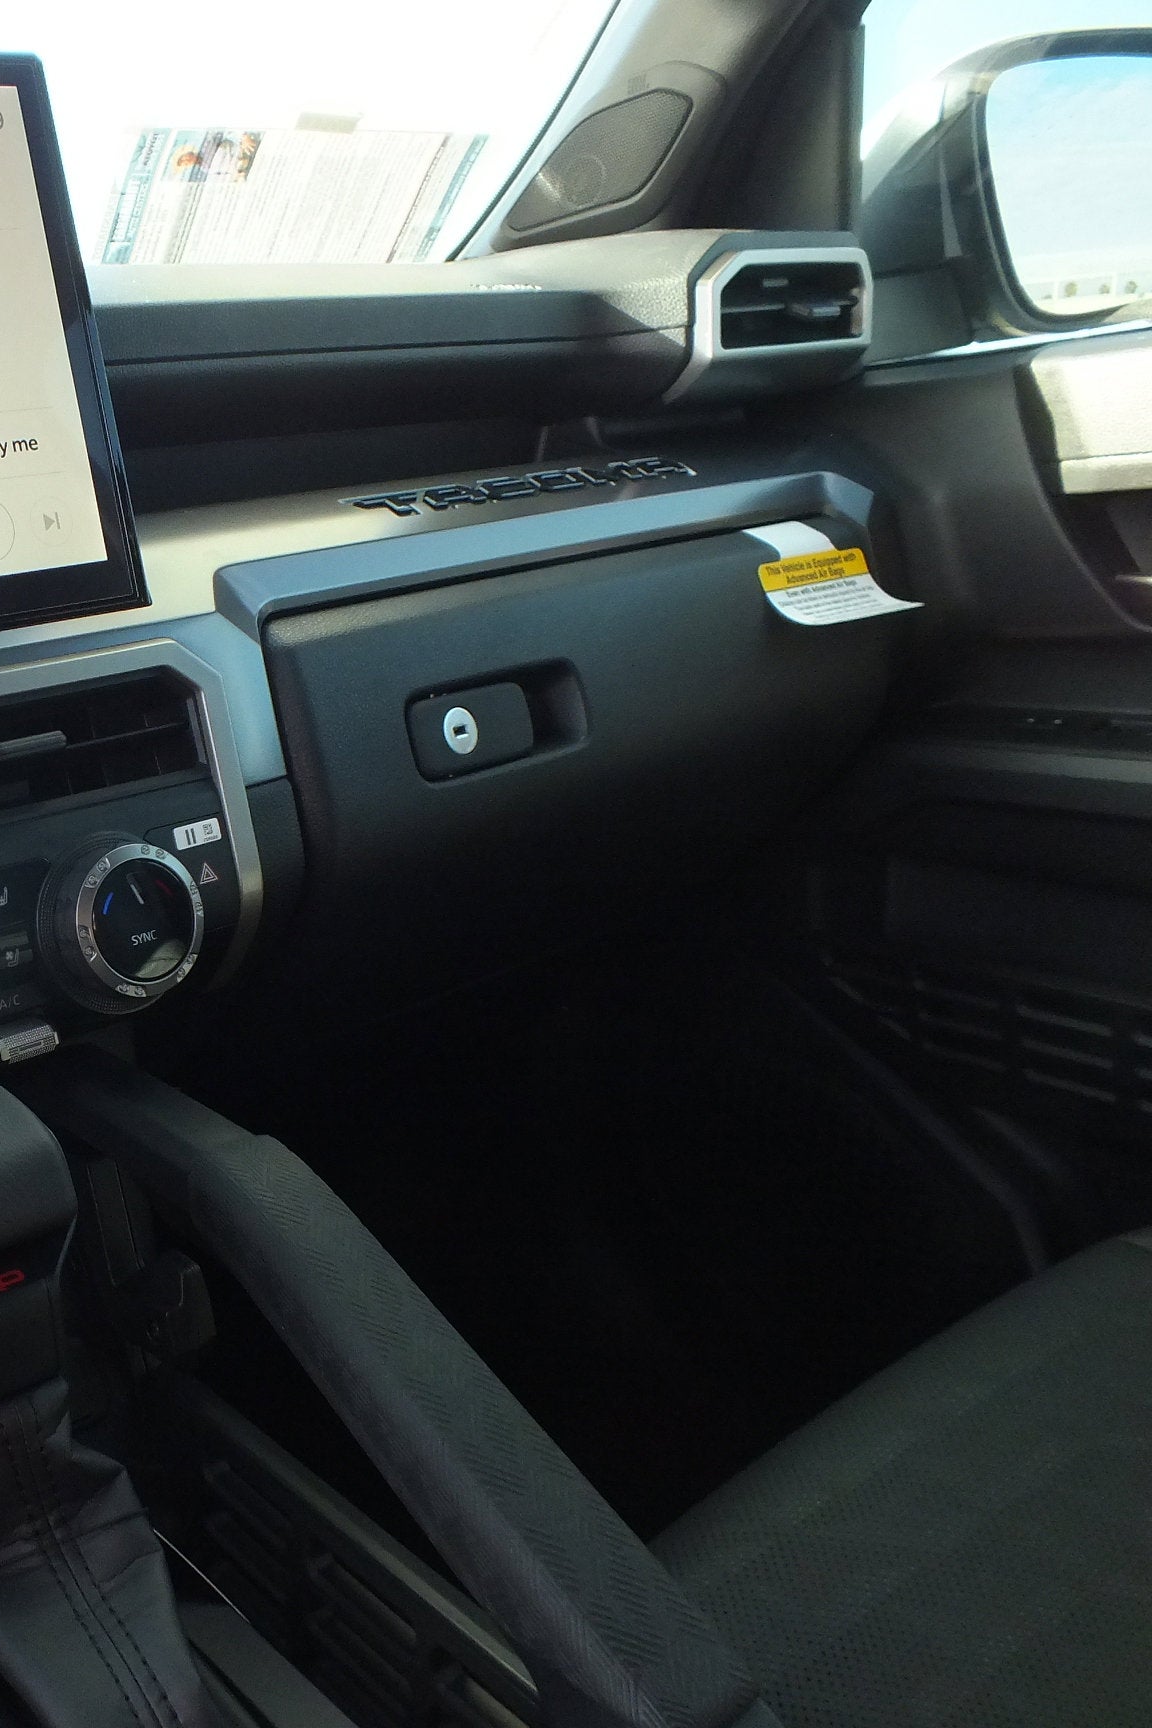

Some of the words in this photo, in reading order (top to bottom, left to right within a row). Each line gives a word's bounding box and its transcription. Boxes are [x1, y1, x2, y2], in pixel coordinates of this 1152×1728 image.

[12, 437, 39, 453] me
[131, 929, 157, 946] SYNC
[0, 994, 19, 1010] A/C
